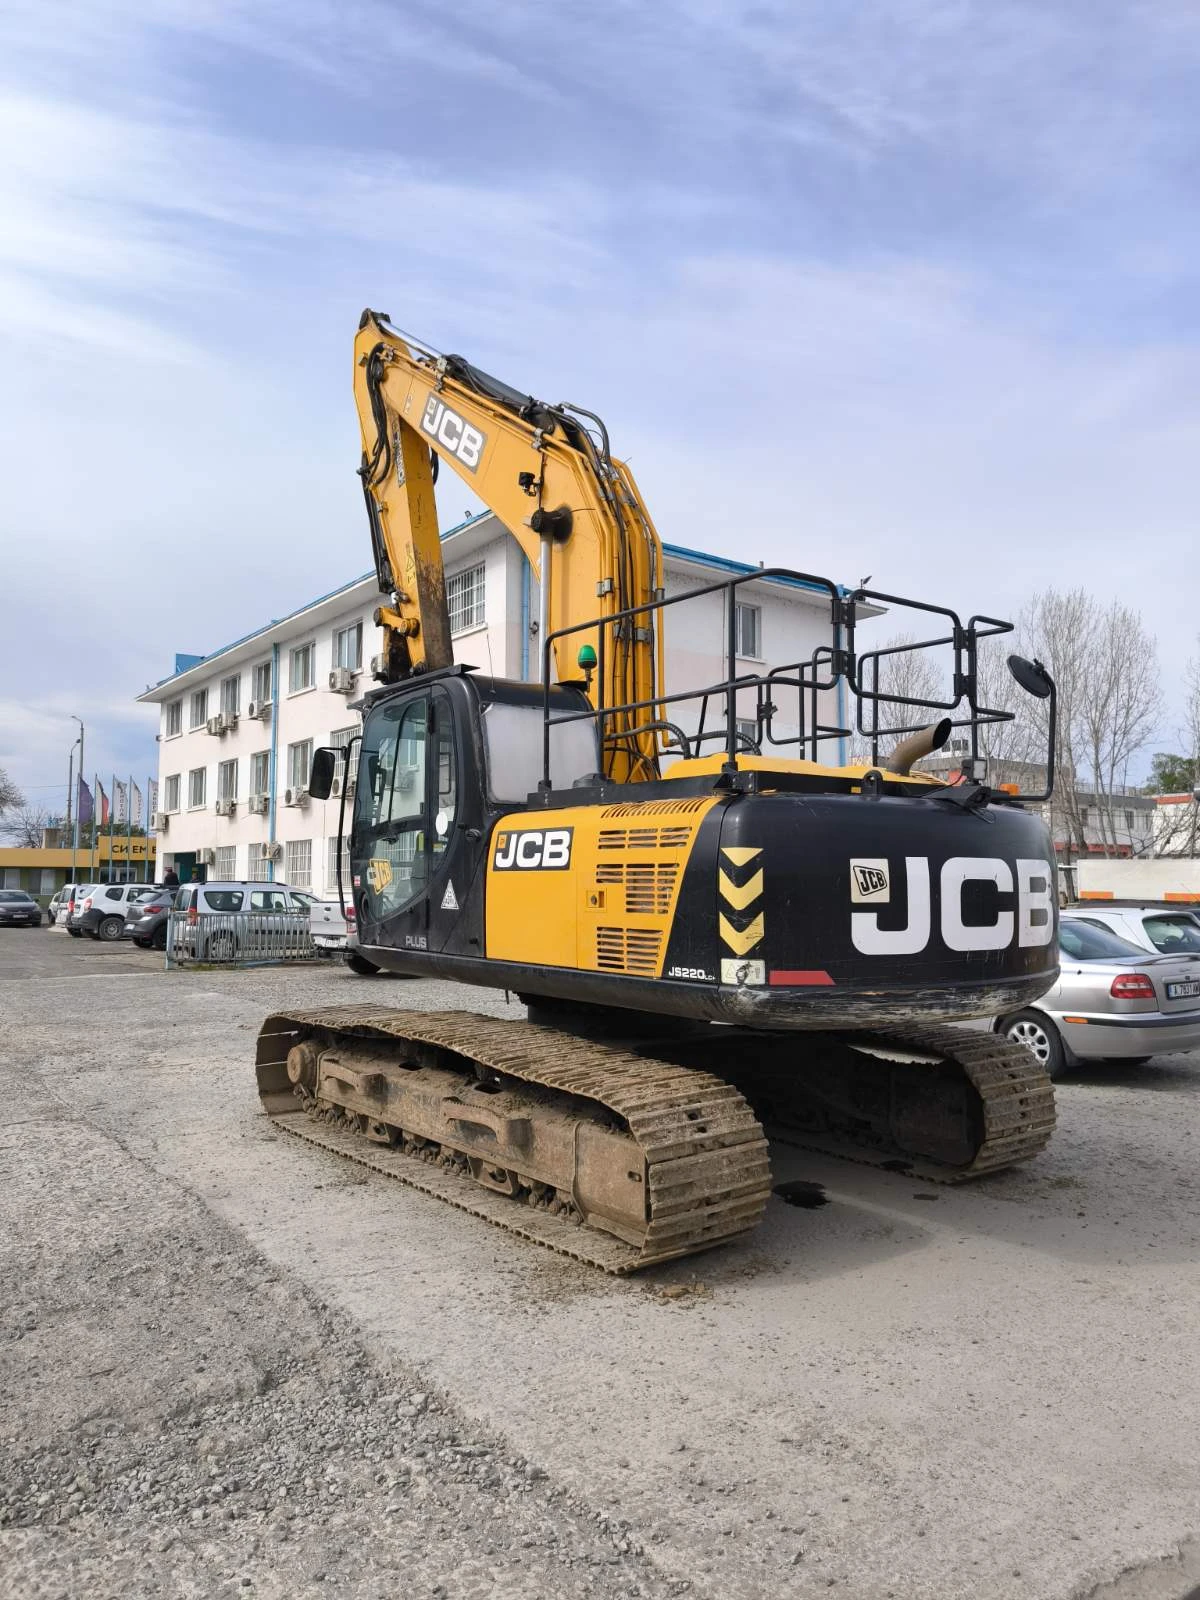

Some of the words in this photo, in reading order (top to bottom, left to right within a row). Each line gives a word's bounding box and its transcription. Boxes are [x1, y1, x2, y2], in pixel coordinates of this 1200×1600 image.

[423, 403, 483, 467] JCB
[495, 830, 571, 868] JCB
[373, 860, 392, 892] JCB
[859, 869, 885, 893] JCB
[851, 856, 1054, 956] JCB
[405, 935, 427, 949] PLUS
